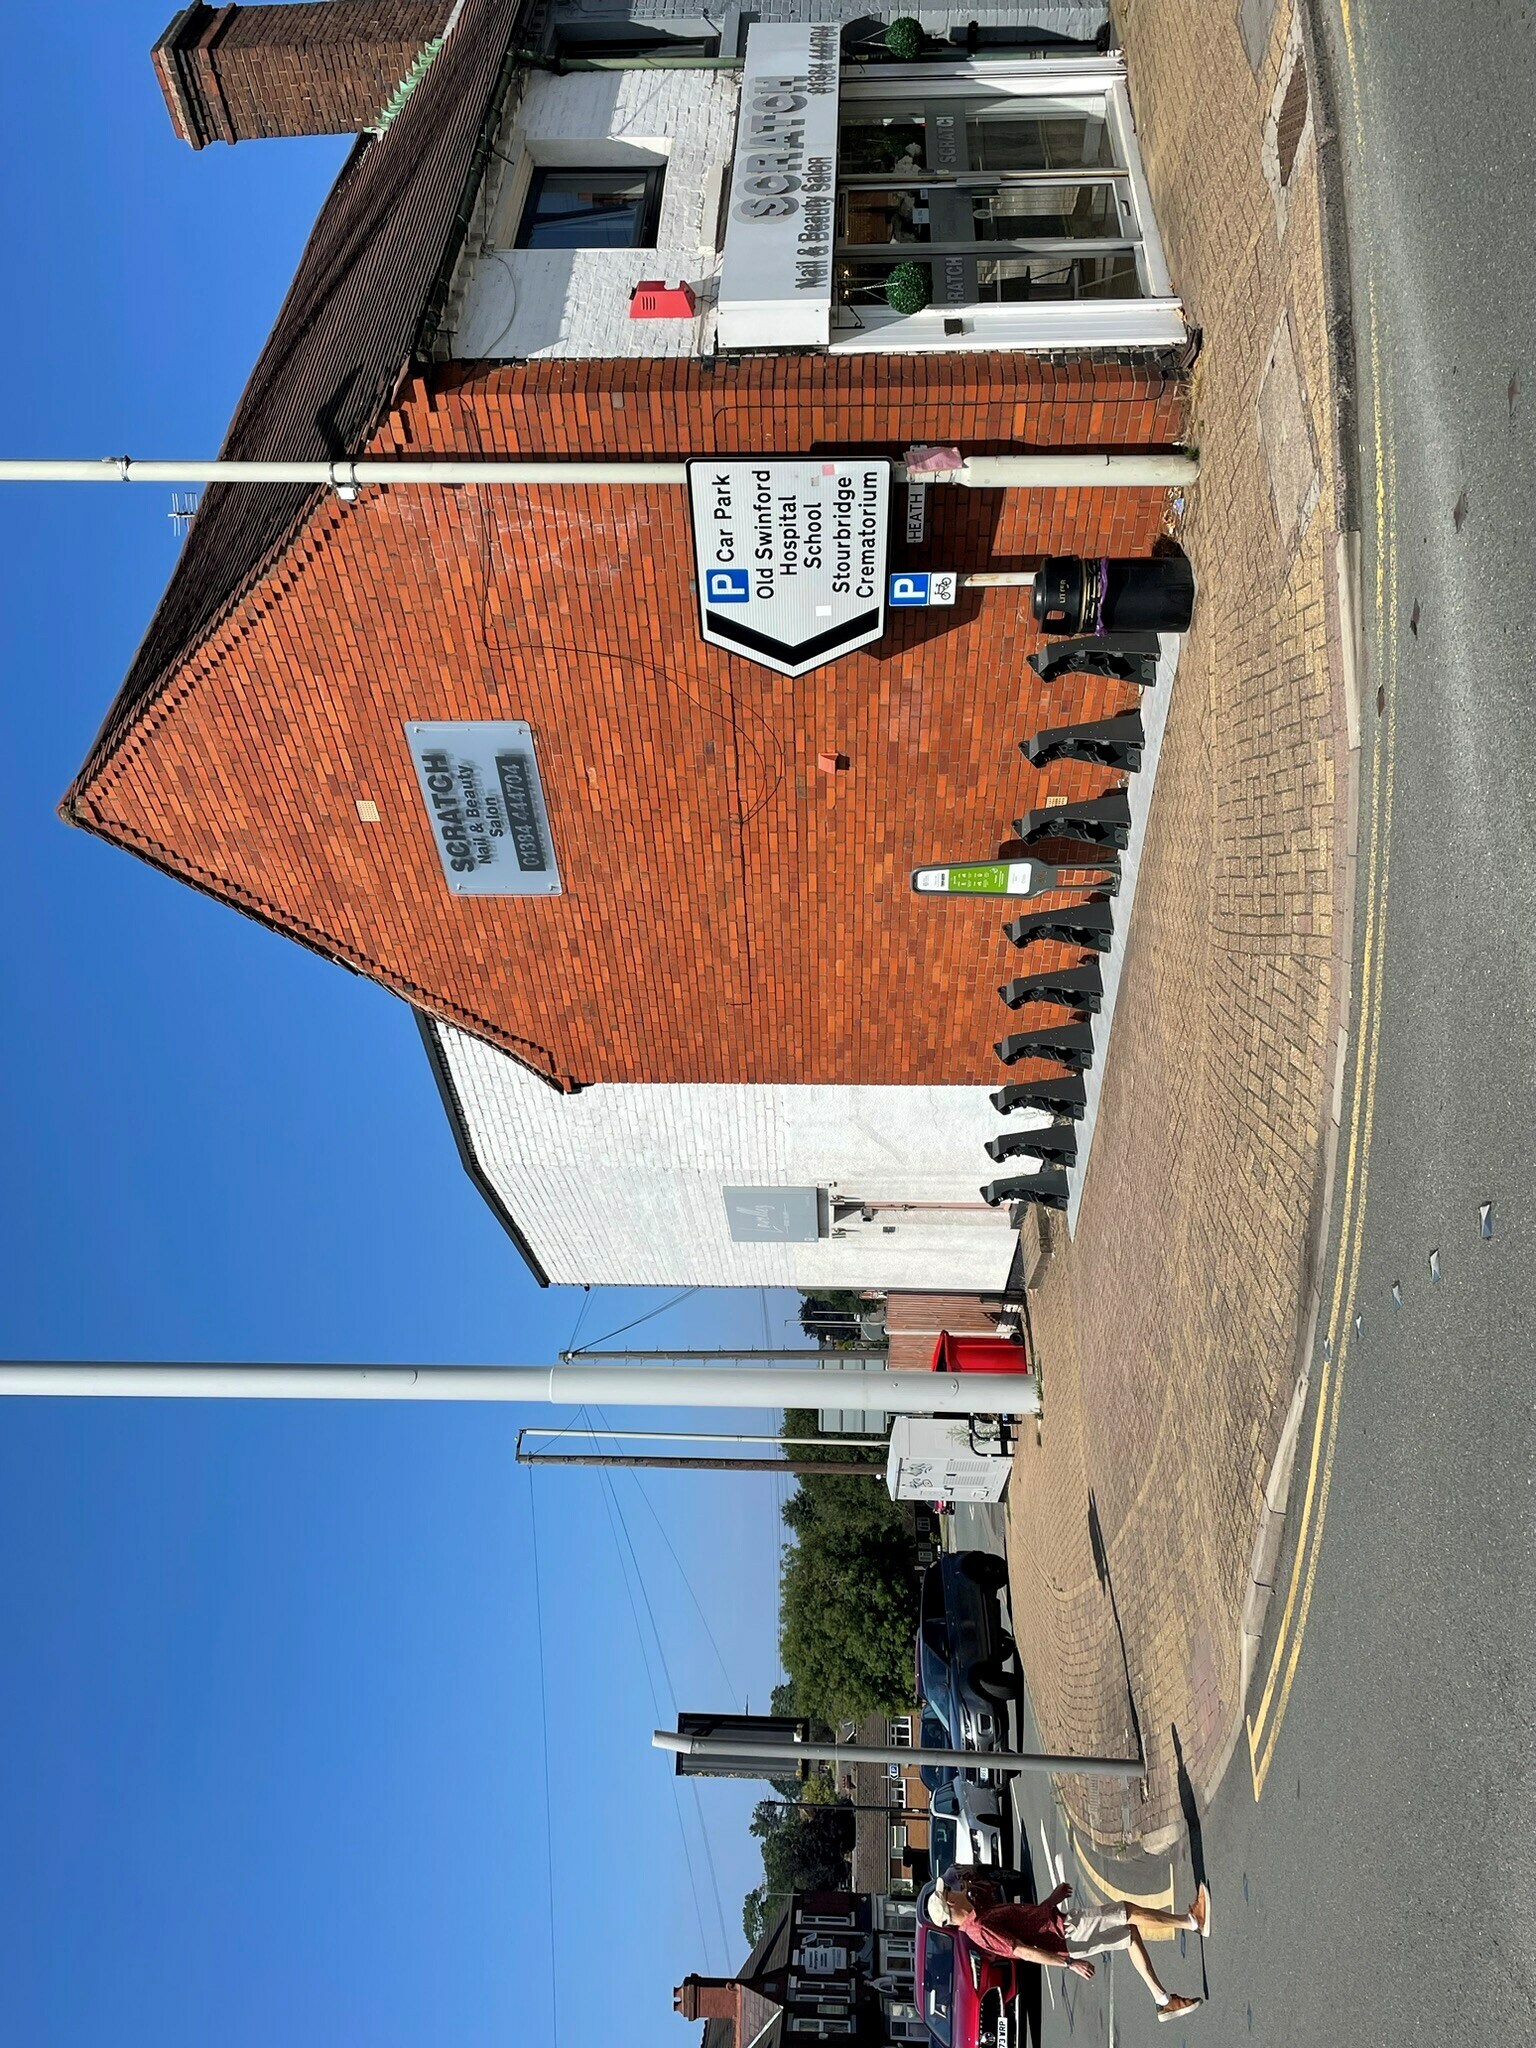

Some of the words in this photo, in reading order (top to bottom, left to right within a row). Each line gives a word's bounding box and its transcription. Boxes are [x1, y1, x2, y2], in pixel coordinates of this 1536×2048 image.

[740, 75, 800, 218] SCRATCH
[801, 157, 830, 192] Salon
[798, 195, 830, 243] Beauty
[795, 261, 825, 289] Nail
[797, 247, 826, 258] &
[945, 257, 964, 303] RATCH
[712, 474, 732, 519] Park
[752, 470, 773, 560] Swinford
[908, 494, 922, 539] HEATH
[716, 529, 734, 562] Car
[778, 495, 800, 575] Hospital
[803, 502, 822, 569] School
[832, 477, 855, 593] Stourbridge
[856, 472, 877, 598] Crematorium
[711, 574, 745, 595] P
[756, 568, 774, 599] Old
[894, 578, 925, 598] P
[421, 755, 474, 872] SCRATCH
[457, 765, 480, 817] Beauty
[501, 764, 530, 820] 444704
[469, 823, 484, 833] &
[485, 797, 503, 837] Salon
[473, 838, 491, 864] Nail
[515, 824, 539, 865] 01384
